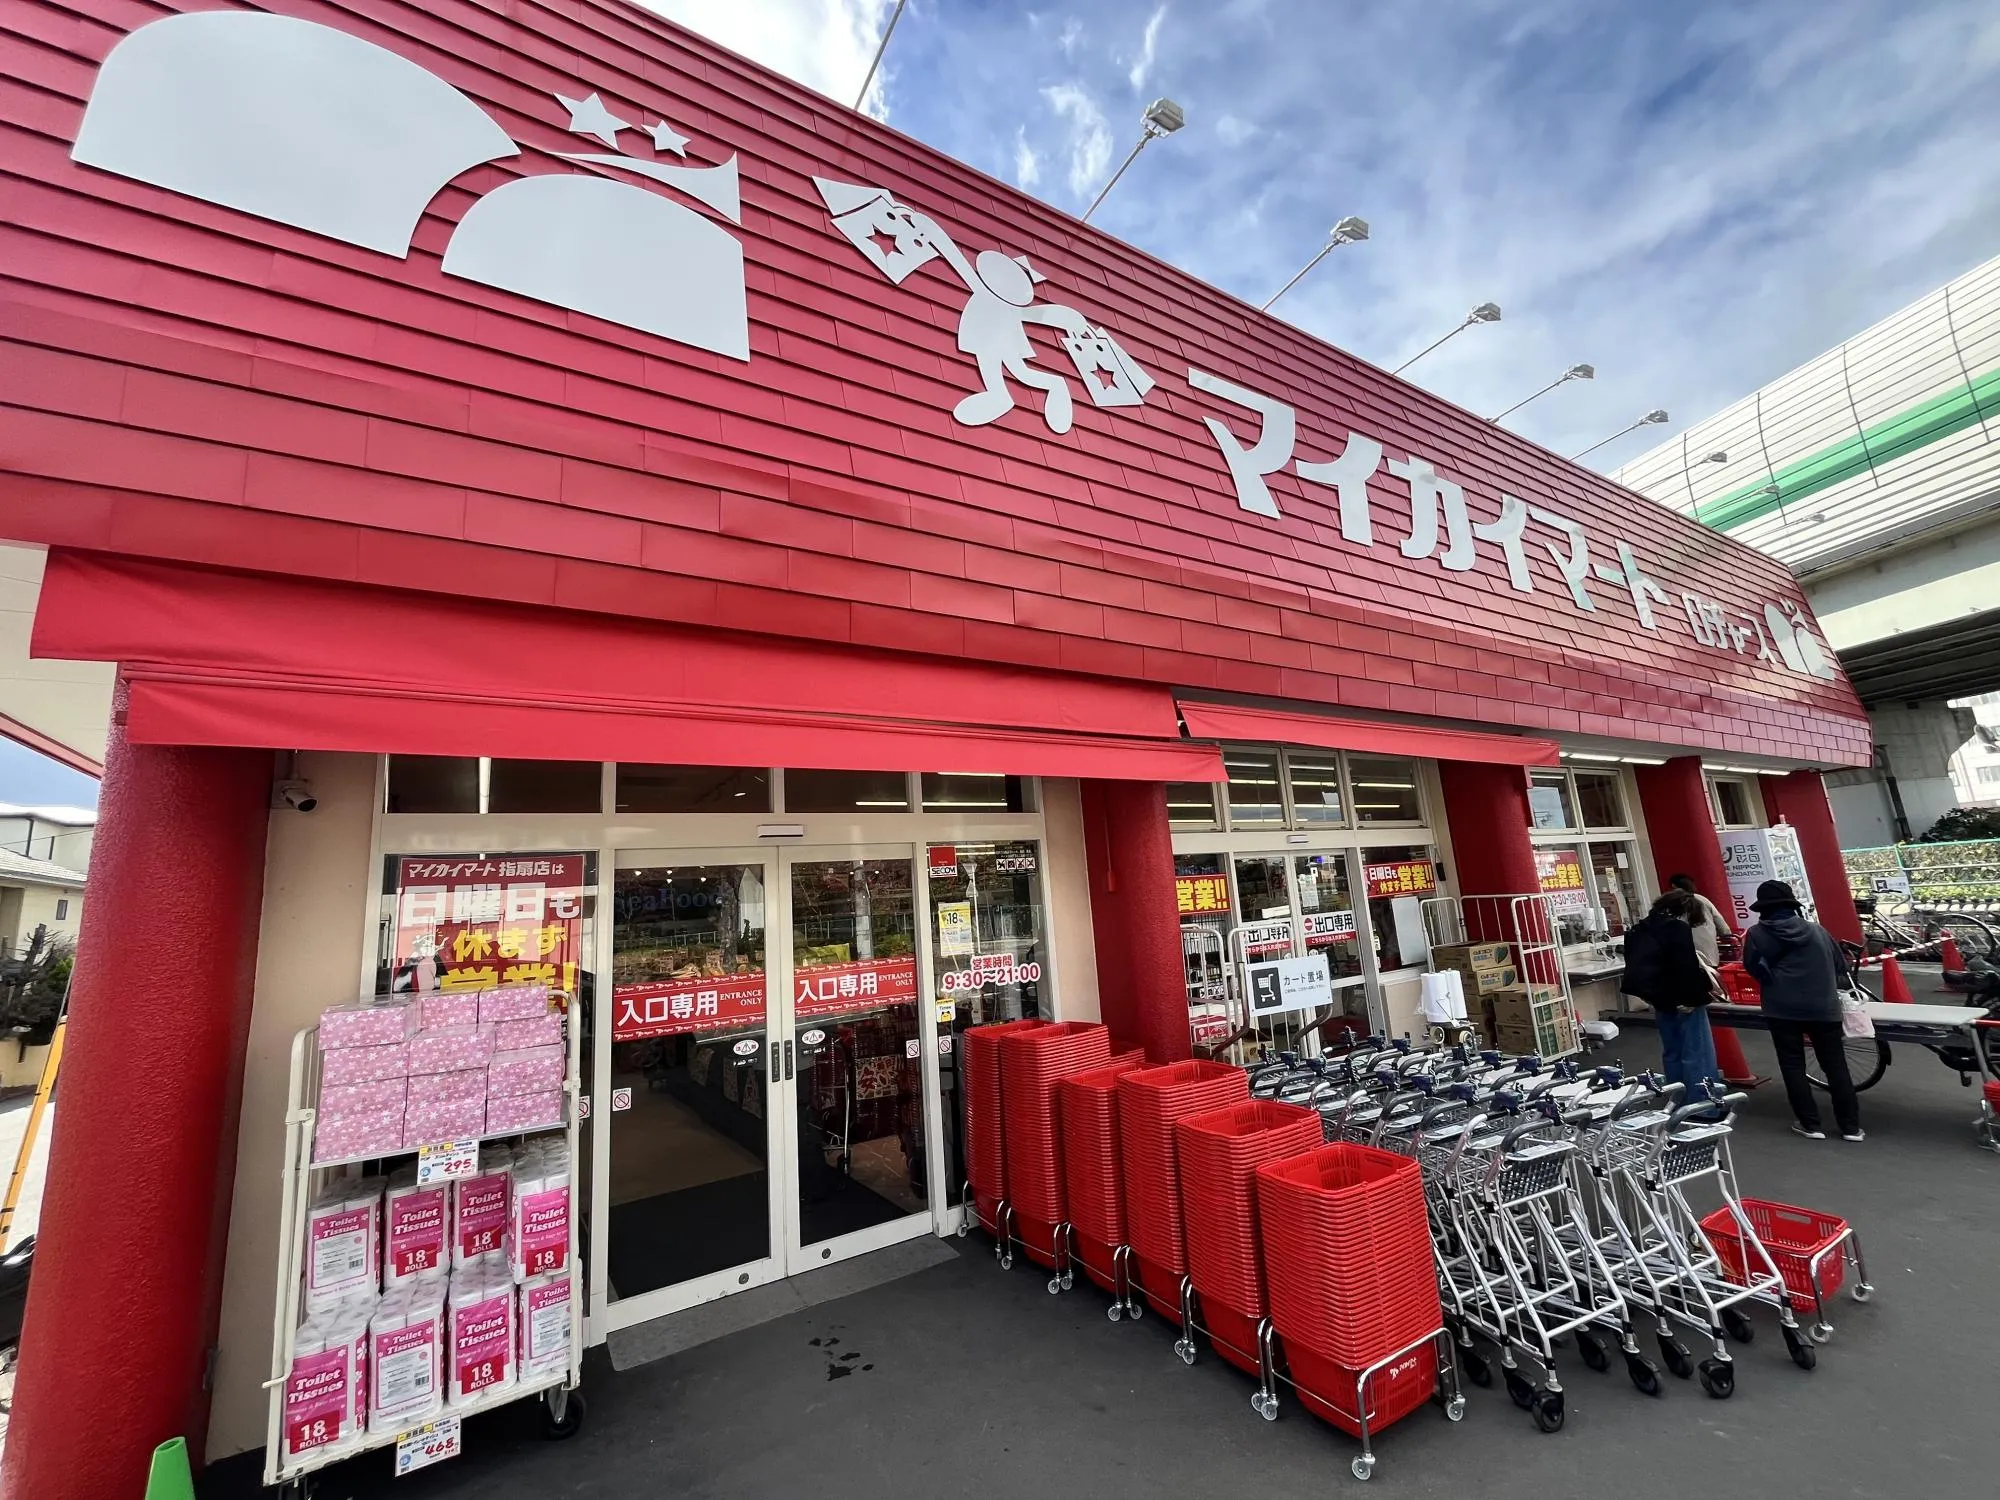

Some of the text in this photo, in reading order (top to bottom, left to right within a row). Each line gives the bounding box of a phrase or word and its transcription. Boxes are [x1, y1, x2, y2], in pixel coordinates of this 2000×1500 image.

[1188, 367, 1671, 631] マイカイマート
[408, 861, 564, 877] マイカイマート 指扇店は
[1727, 870, 1764, 878] UNDATION
[402, 881, 580, 926] 日曜日も
[1314, 913, 1354, 933] 出口専用
[453, 924, 568, 962] 休まず
[972, 955, 1012, 970] 営業時間
[879, 972, 913, 982] ENTRANCE
[895, 978, 913, 987] ONLY
[1284, 970, 1324, 986] カート置場
[719, 989, 763, 1001] ENTRANCE
[797, 971, 878, 1004] 入口専用
[617, 990, 718, 1027] 入口専用
[740, 997, 763, 1006] ONLY
[444, 1158, 472, 1172] 295
[469, 1191, 503, 1206] Toilet
[402, 1208, 439, 1223] Toilet
[461, 1200, 504, 1217] Tissues
[530, 1206, 565, 1222] Toilet
[329, 1216, 358, 1228] Toilet
[394, 1218, 441, 1235] Tissues
[524, 1216, 567, 1234] Tissues
[323, 1224, 359, 1237] Tissues
[473, 1231, 491, 1247] 18
[405, 1249, 426, 1265] 18
[535, 1250, 554, 1266] 18
[544, 1285, 568, 1298] Toilet
[539, 1293, 570, 1308] Tissues
[466, 1316, 504, 1335] Toilet
[392, 1330, 422, 1344] Toilet
[459, 1326, 507, 1349] Tissues
[386, 1339, 424, 1354] Tissues
[295, 1369, 341, 1390] Toilet
[471, 1362, 492, 1381] 18
[288, 1380, 344, 1403] Tissues
[301, 1419, 326, 1440] 18
[425, 1437, 455, 1455] 468
